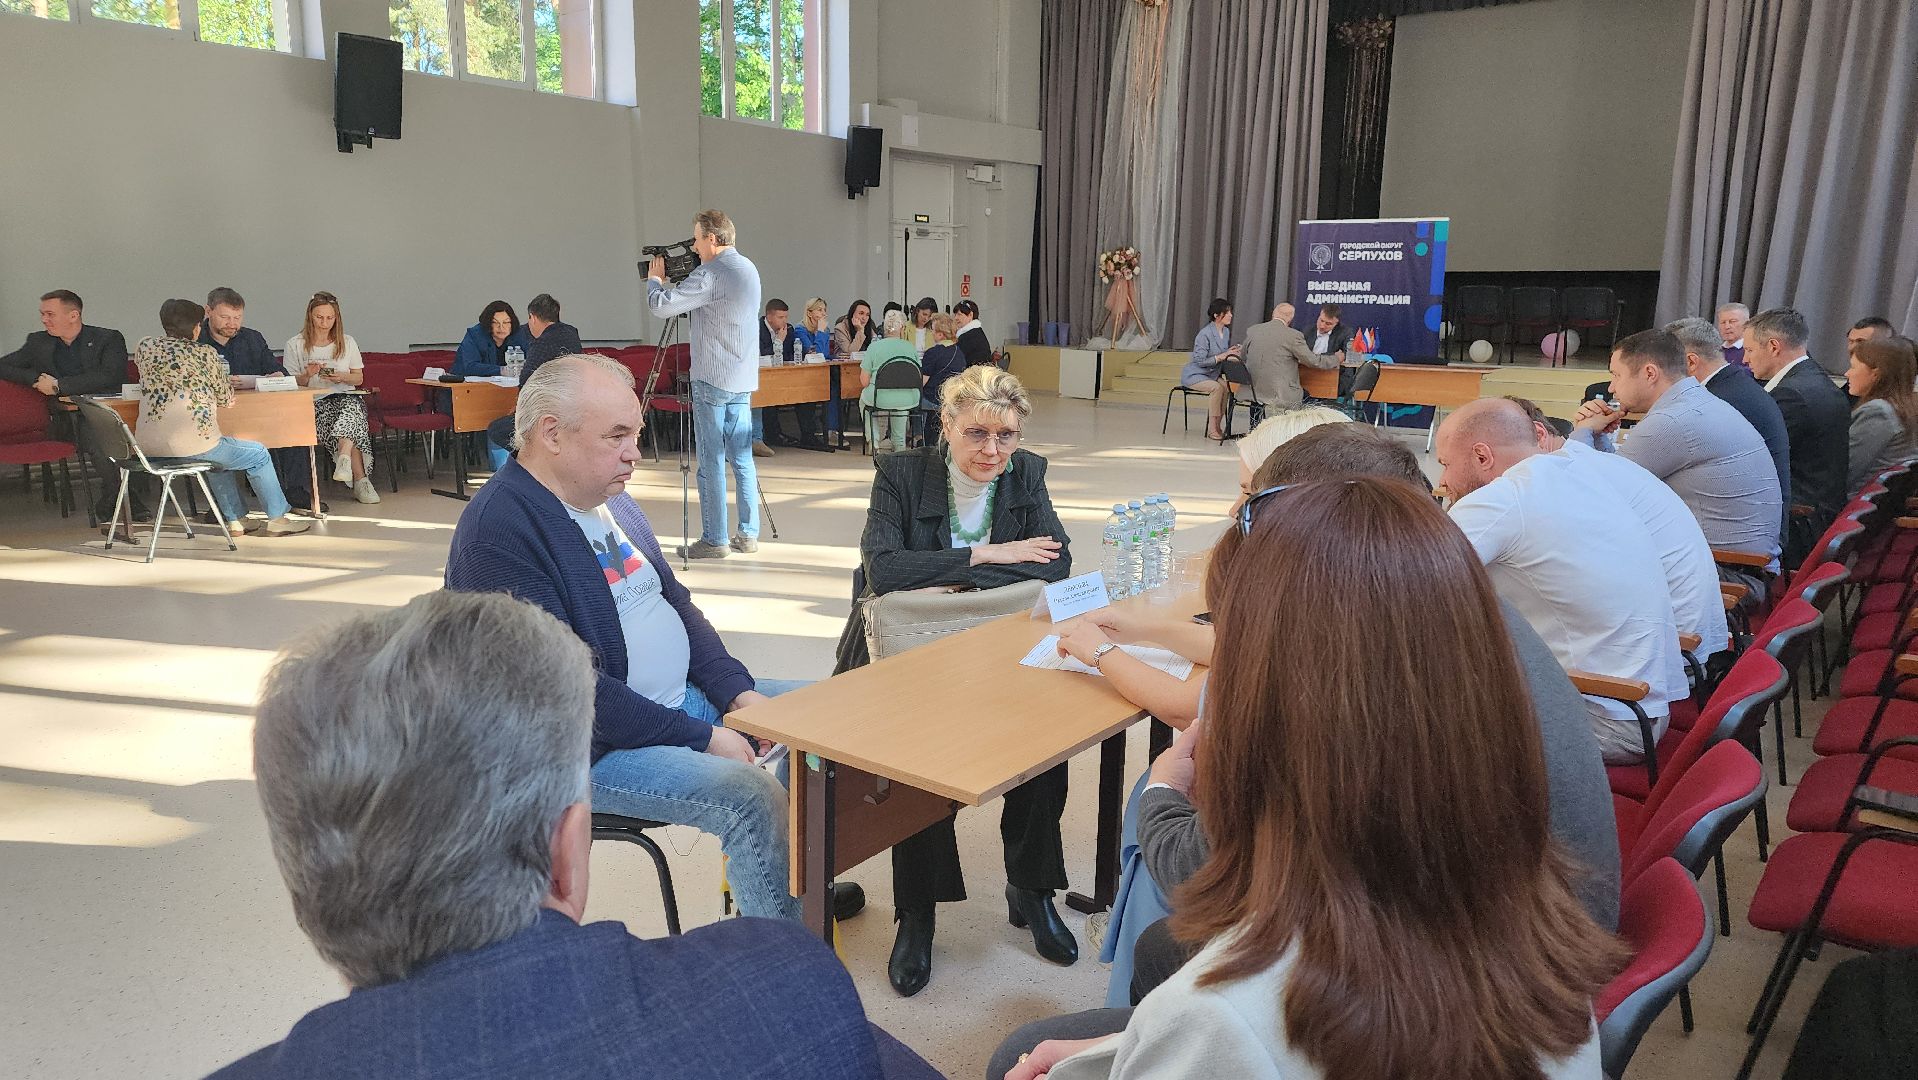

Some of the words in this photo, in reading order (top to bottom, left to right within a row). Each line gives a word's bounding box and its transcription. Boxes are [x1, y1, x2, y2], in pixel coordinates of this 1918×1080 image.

[1340, 241, 1380, 250] ГОРОДСКОЙ
[1339, 250, 1403, 261] СЕРПУХОВ
[1307, 281, 1371, 292] ВЫЕЗДНАЯ
[1306, 293, 1411, 305] АДМИНИСТРАЦИЯ
